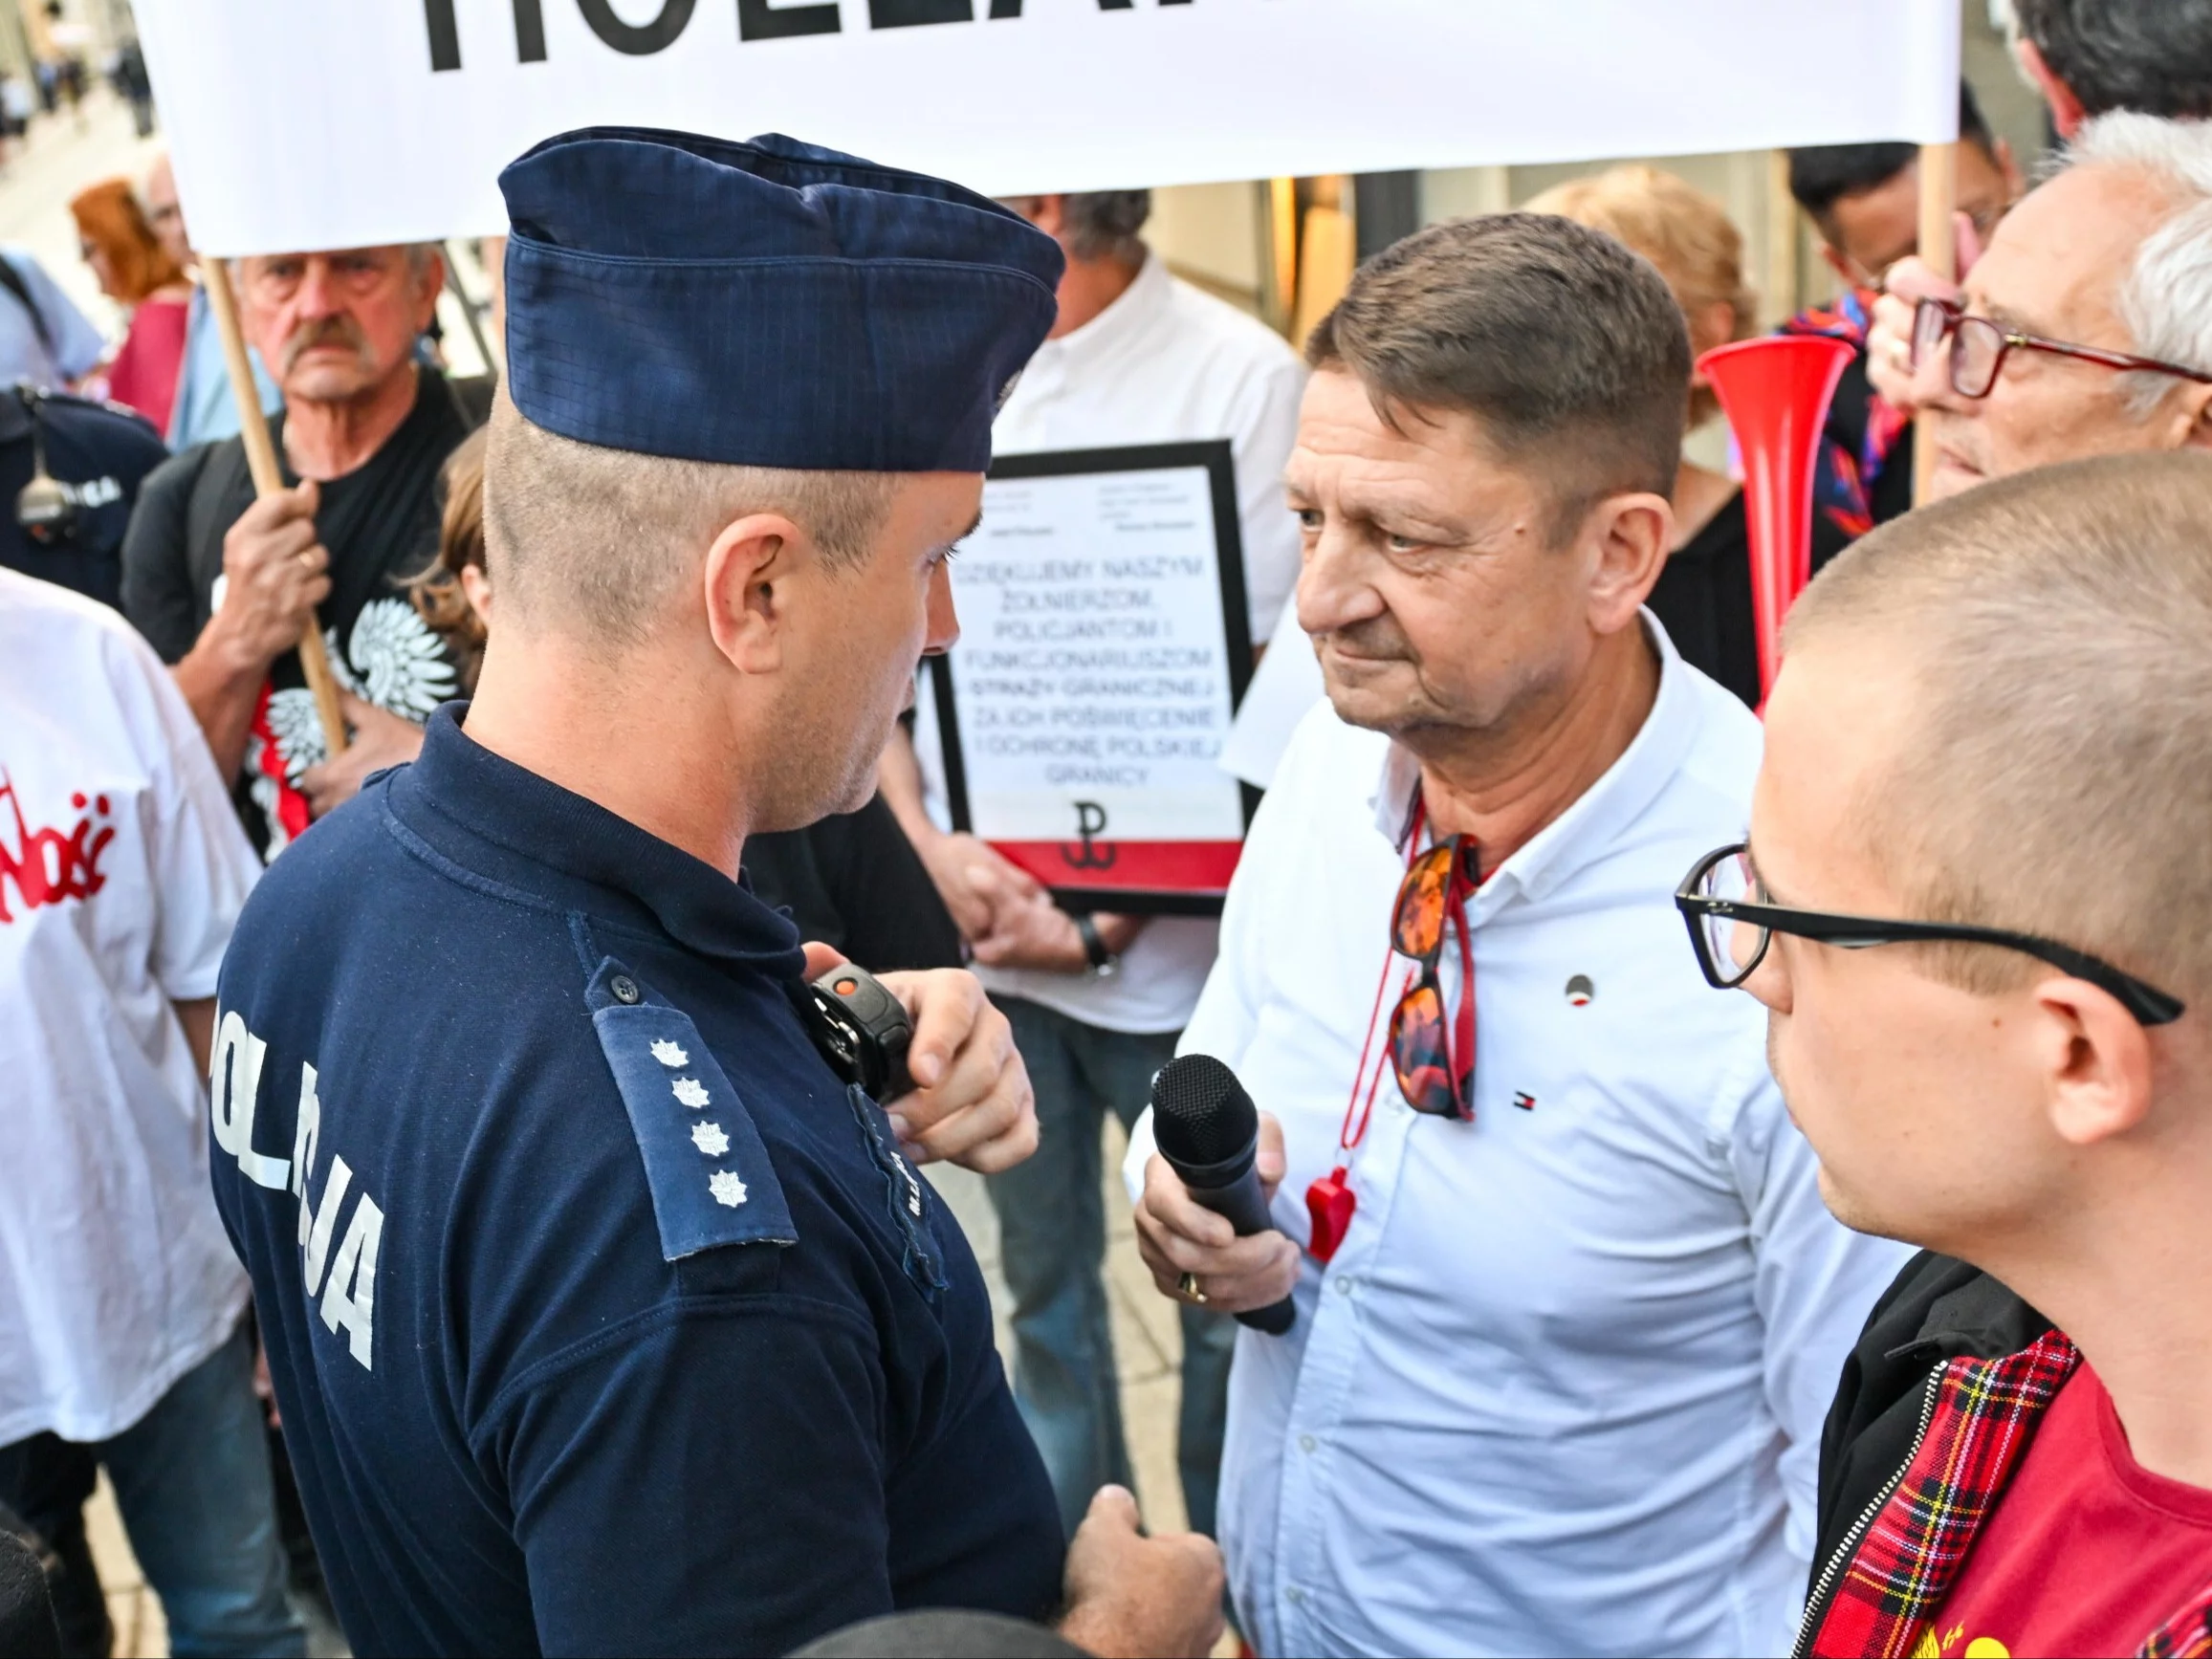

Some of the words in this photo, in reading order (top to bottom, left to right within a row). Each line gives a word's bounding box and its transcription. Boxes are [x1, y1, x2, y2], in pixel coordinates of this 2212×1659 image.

[1102, 556, 1204, 579] NASZYM
[994, 620, 1157, 642] POLICJANTOM
[965, 647, 1212, 670] FUNKCJONARIUSZOM
[970, 676, 1053, 698] STRAŻY
[1061, 677, 1215, 698] GRANICZNEJ
[974, 706, 999, 728] ZA
[1051, 704, 1215, 731] POŚWIĘCENIE
[988, 734, 1102, 759] OCHRONĘ
[1106, 734, 1223, 758] POLSKIEJ
[1044, 767, 1150, 785] GRANICY
[208, 998, 384, 1371] OLICJA
